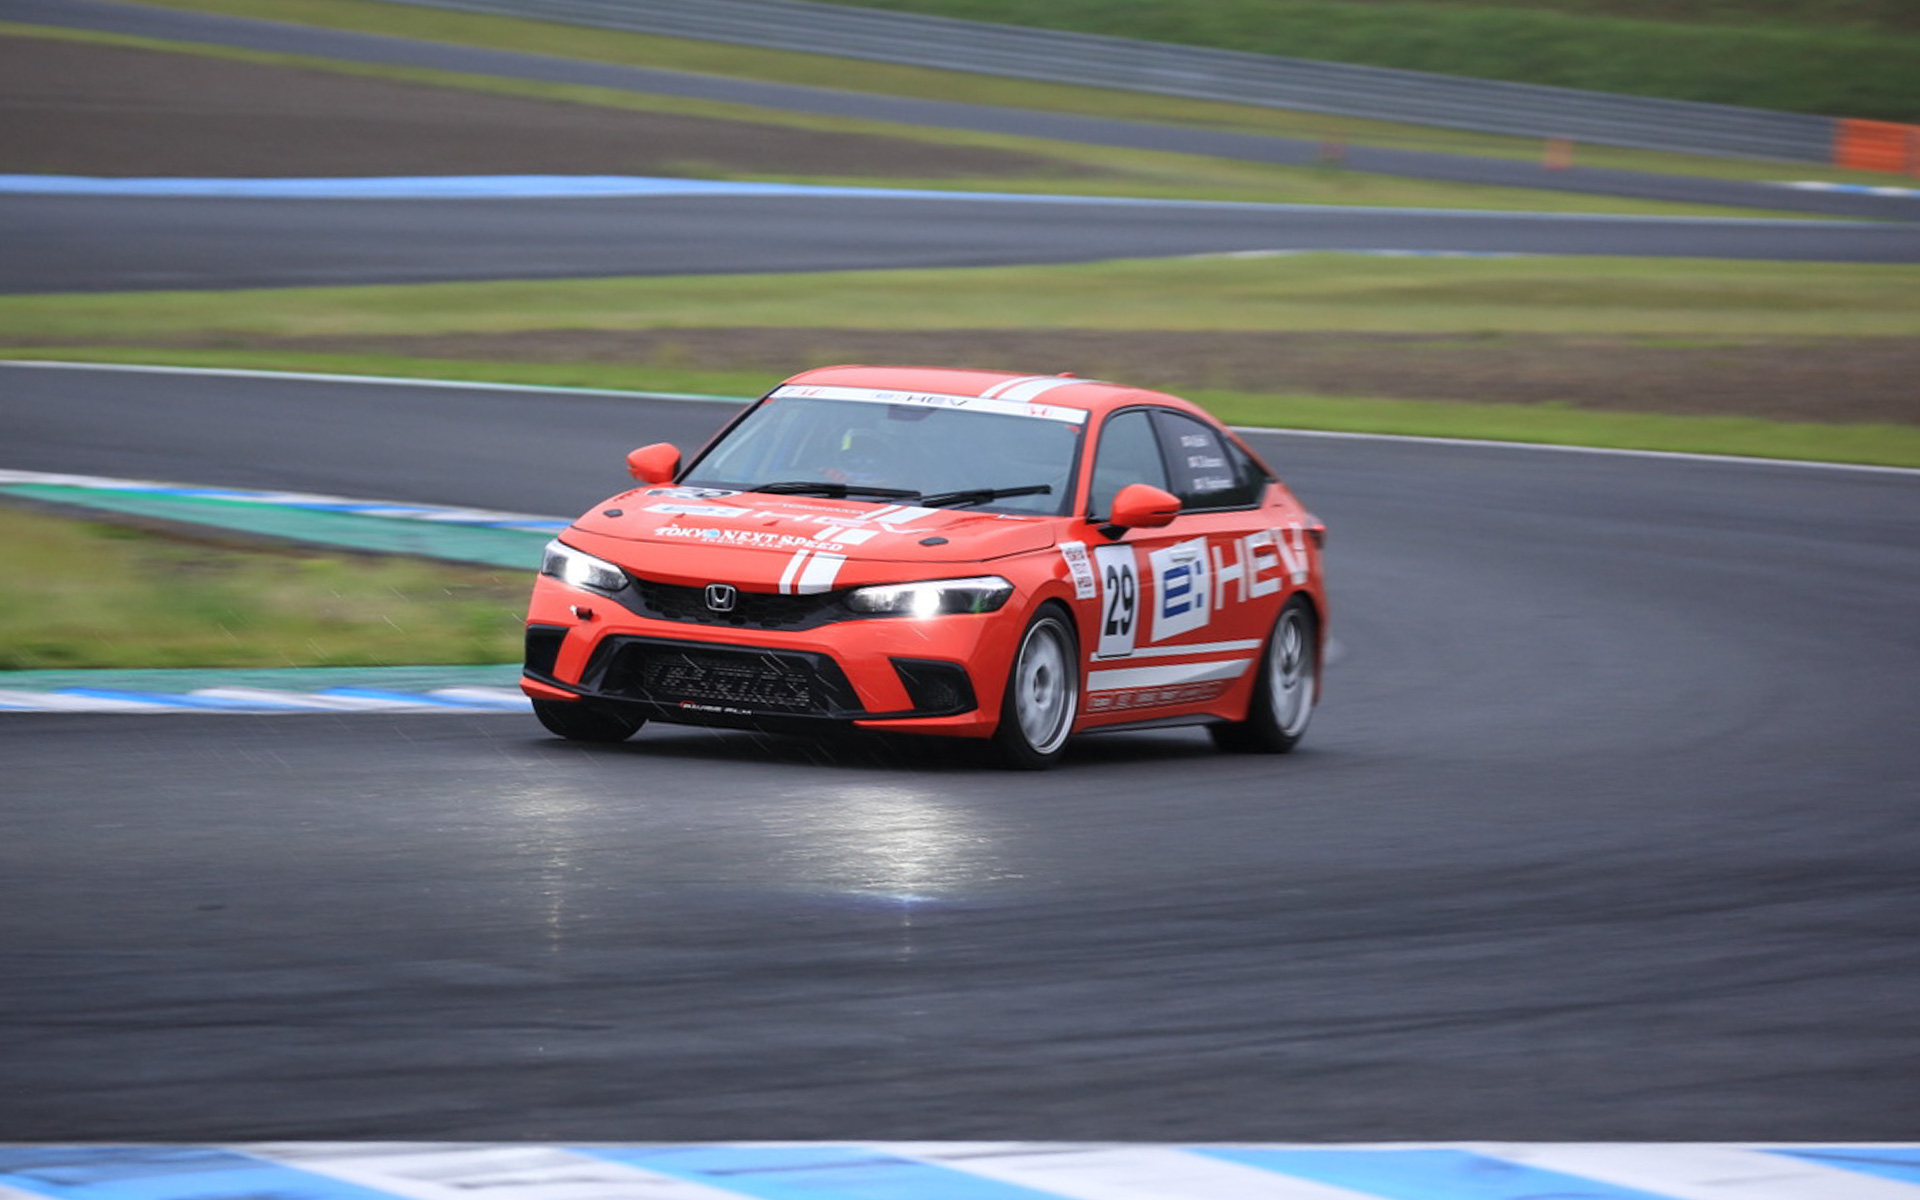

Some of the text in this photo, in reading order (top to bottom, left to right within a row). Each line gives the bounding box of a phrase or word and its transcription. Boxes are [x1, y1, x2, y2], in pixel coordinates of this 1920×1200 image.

[721, 528, 779, 543] NEXT
[779, 535, 844, 551] SPEED
[1212, 522, 1309, 611] HEV
[1105, 564, 1135, 637] 29
